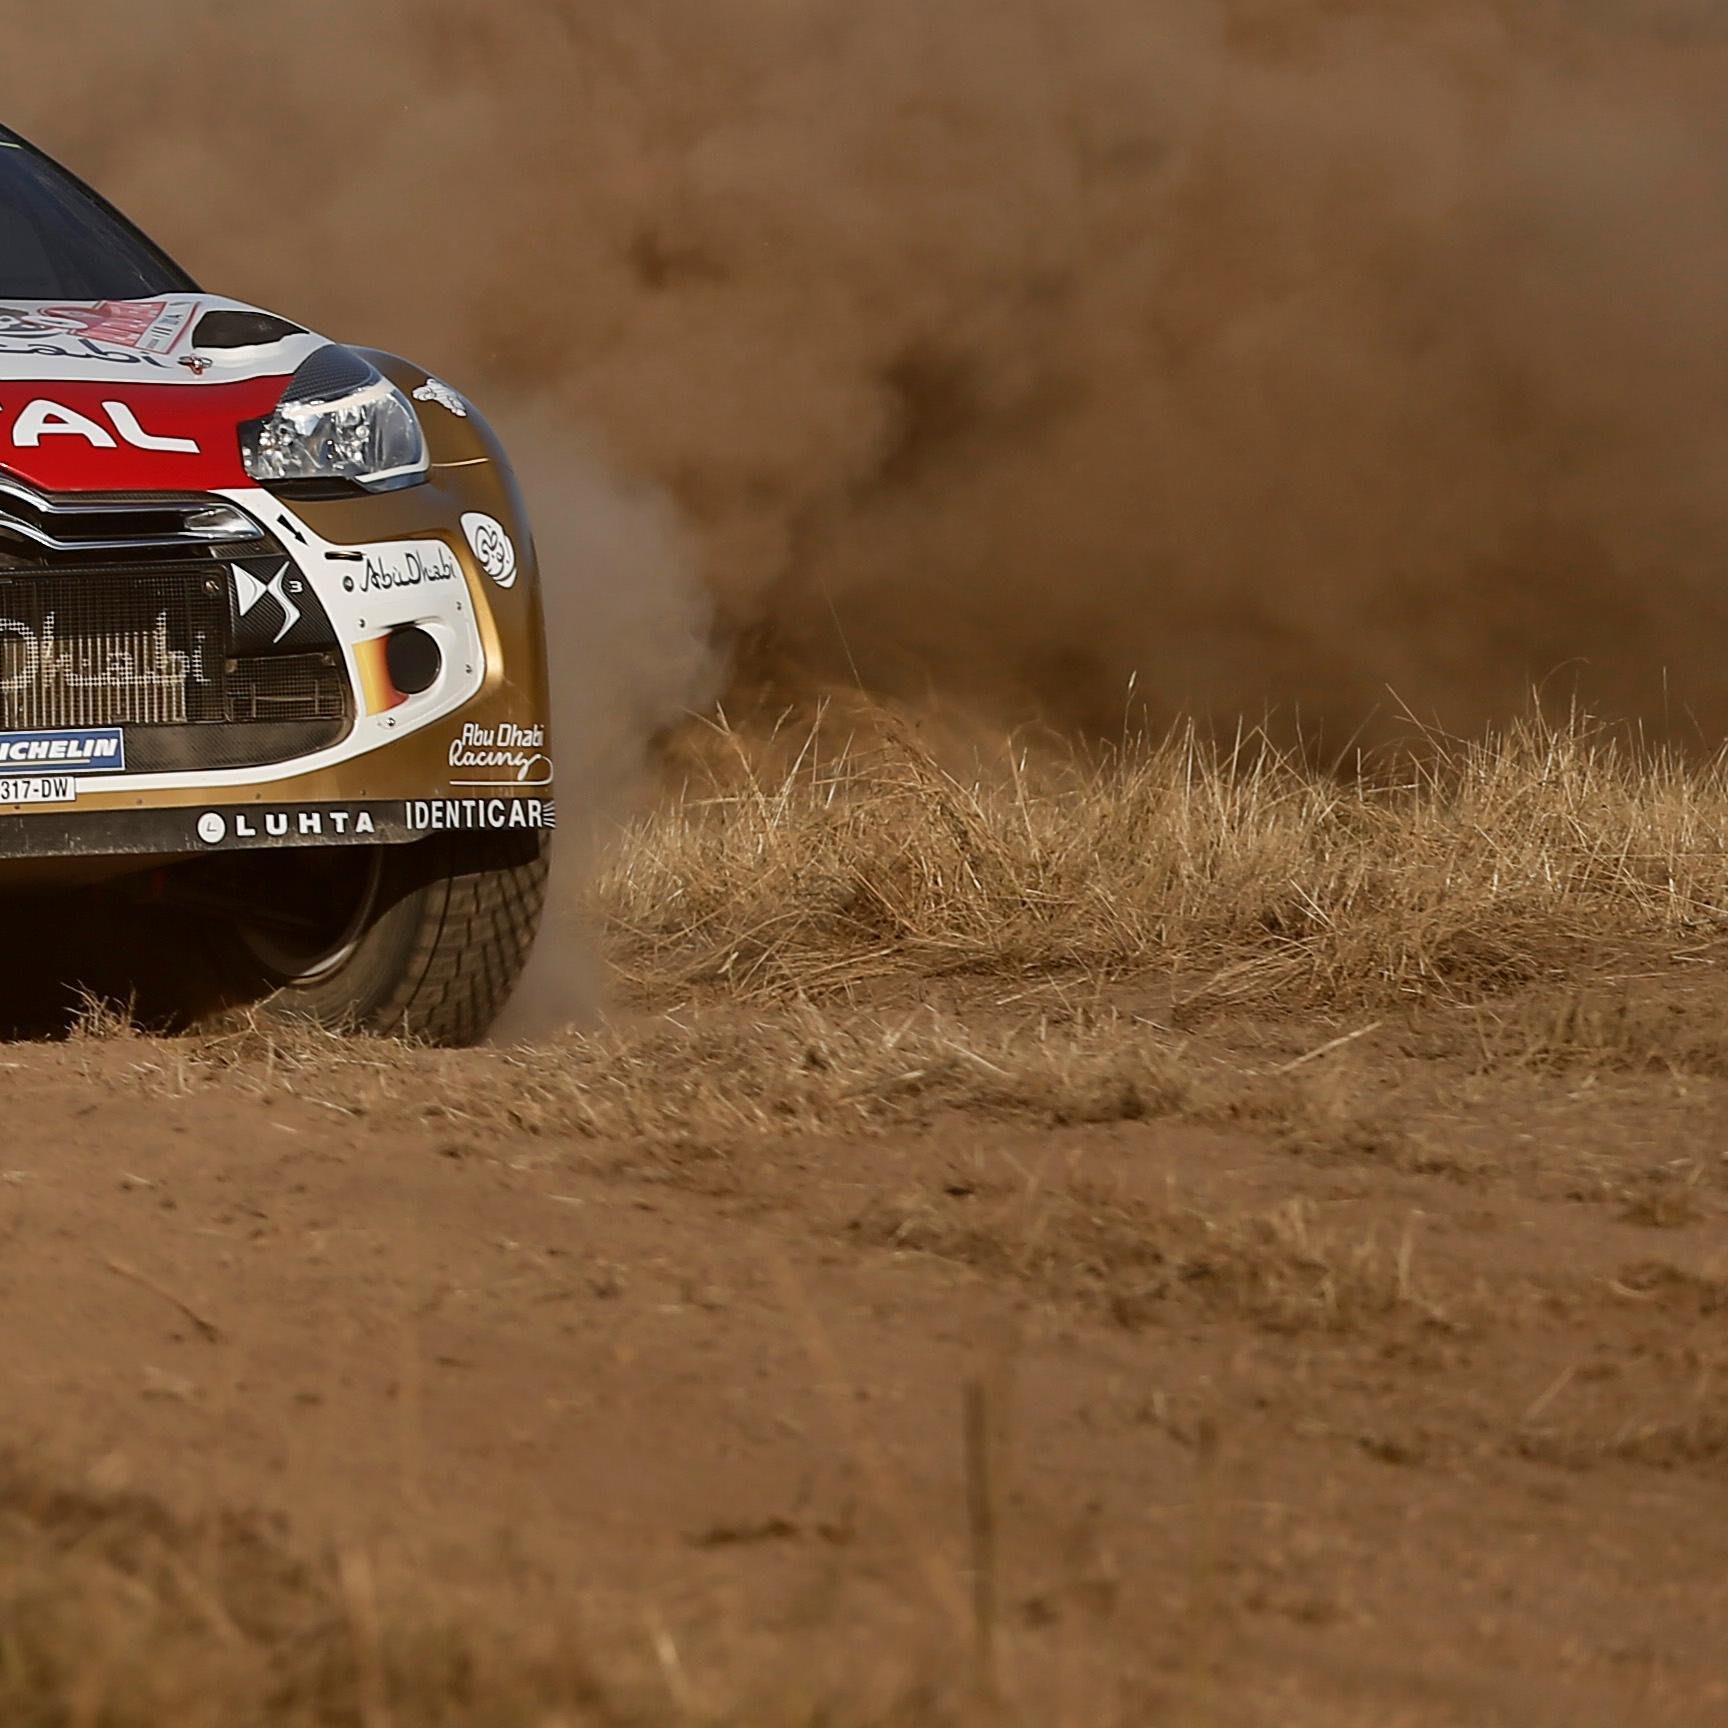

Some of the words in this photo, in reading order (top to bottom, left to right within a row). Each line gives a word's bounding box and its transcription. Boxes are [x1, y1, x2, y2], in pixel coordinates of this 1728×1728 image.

[461, 722, 494, 747] Abu
[496, 722, 545, 747] Dhabi
[449, 739, 542, 782] Racing
[235, 811, 376, 837] LUHTA
[405, 799, 544, 830] IDENTICAR
